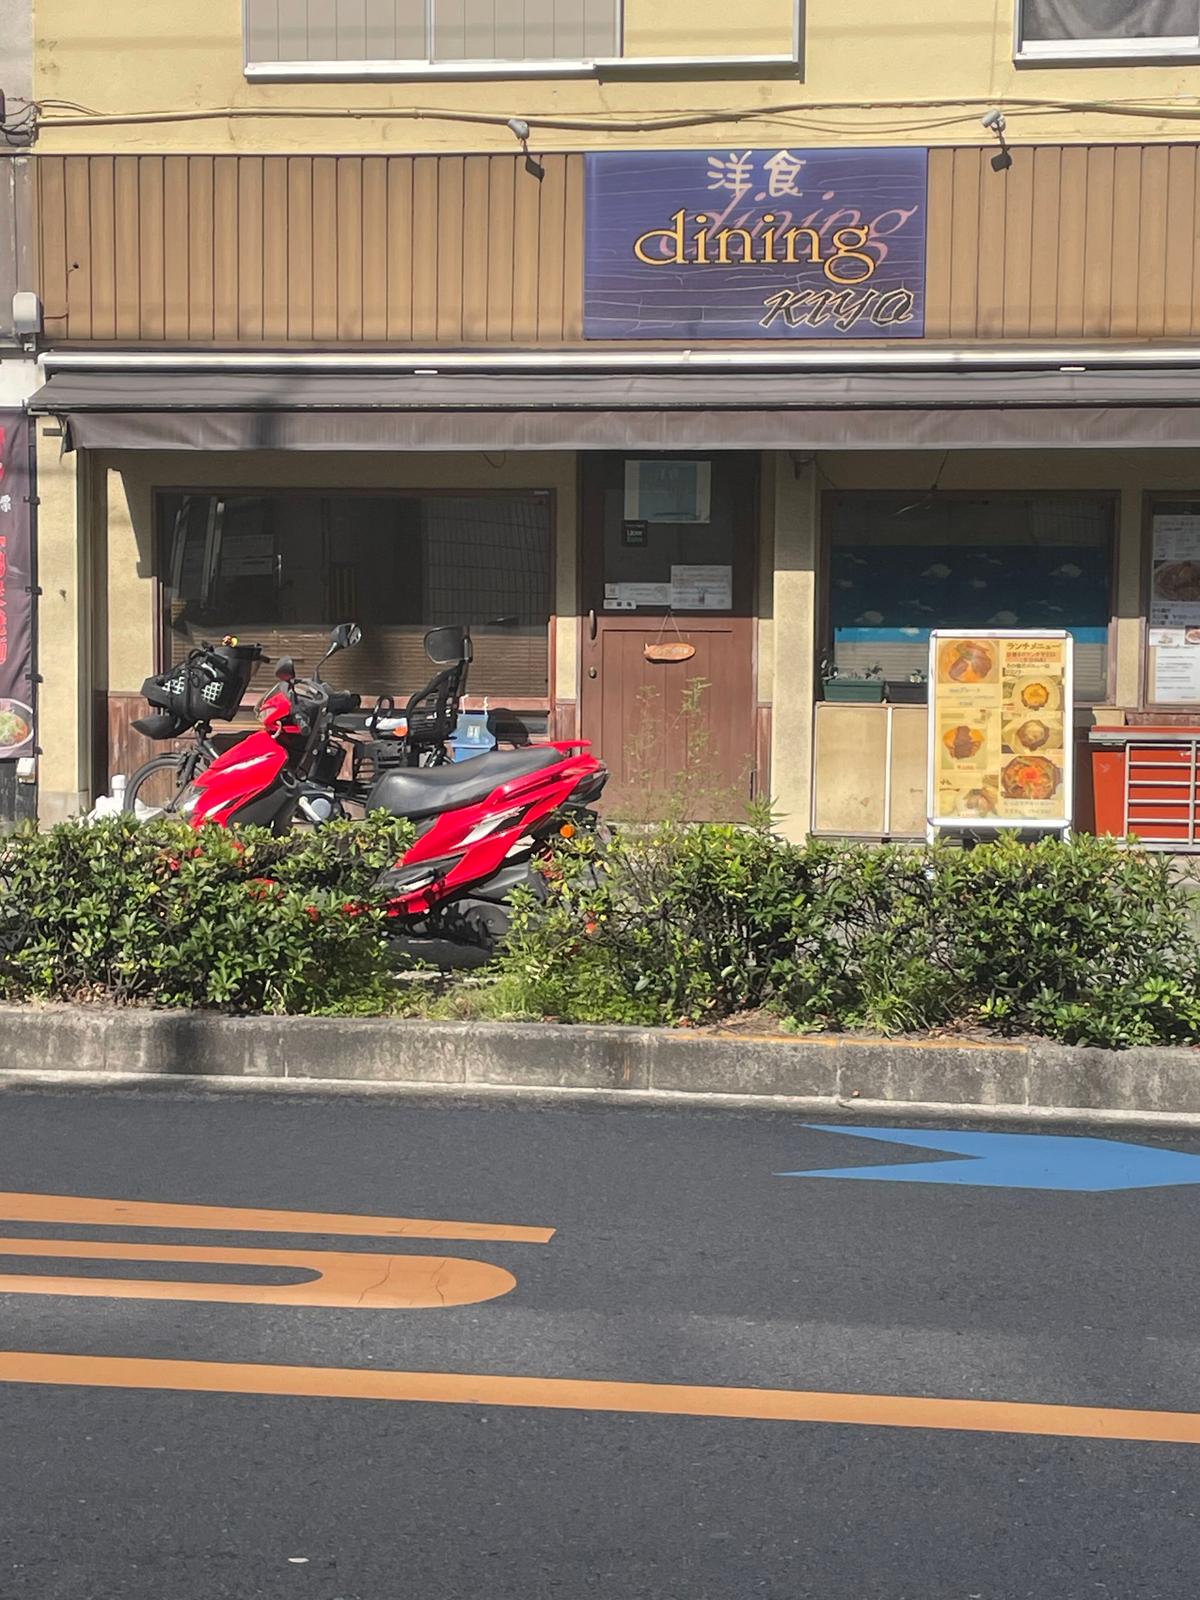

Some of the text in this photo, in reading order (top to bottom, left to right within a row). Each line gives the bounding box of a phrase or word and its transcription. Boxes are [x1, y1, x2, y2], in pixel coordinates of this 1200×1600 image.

[707, 150, 806, 197] 洋食
[633, 208, 876, 284] dining
[1007, 642, 1062, 650] ランチメニュー
